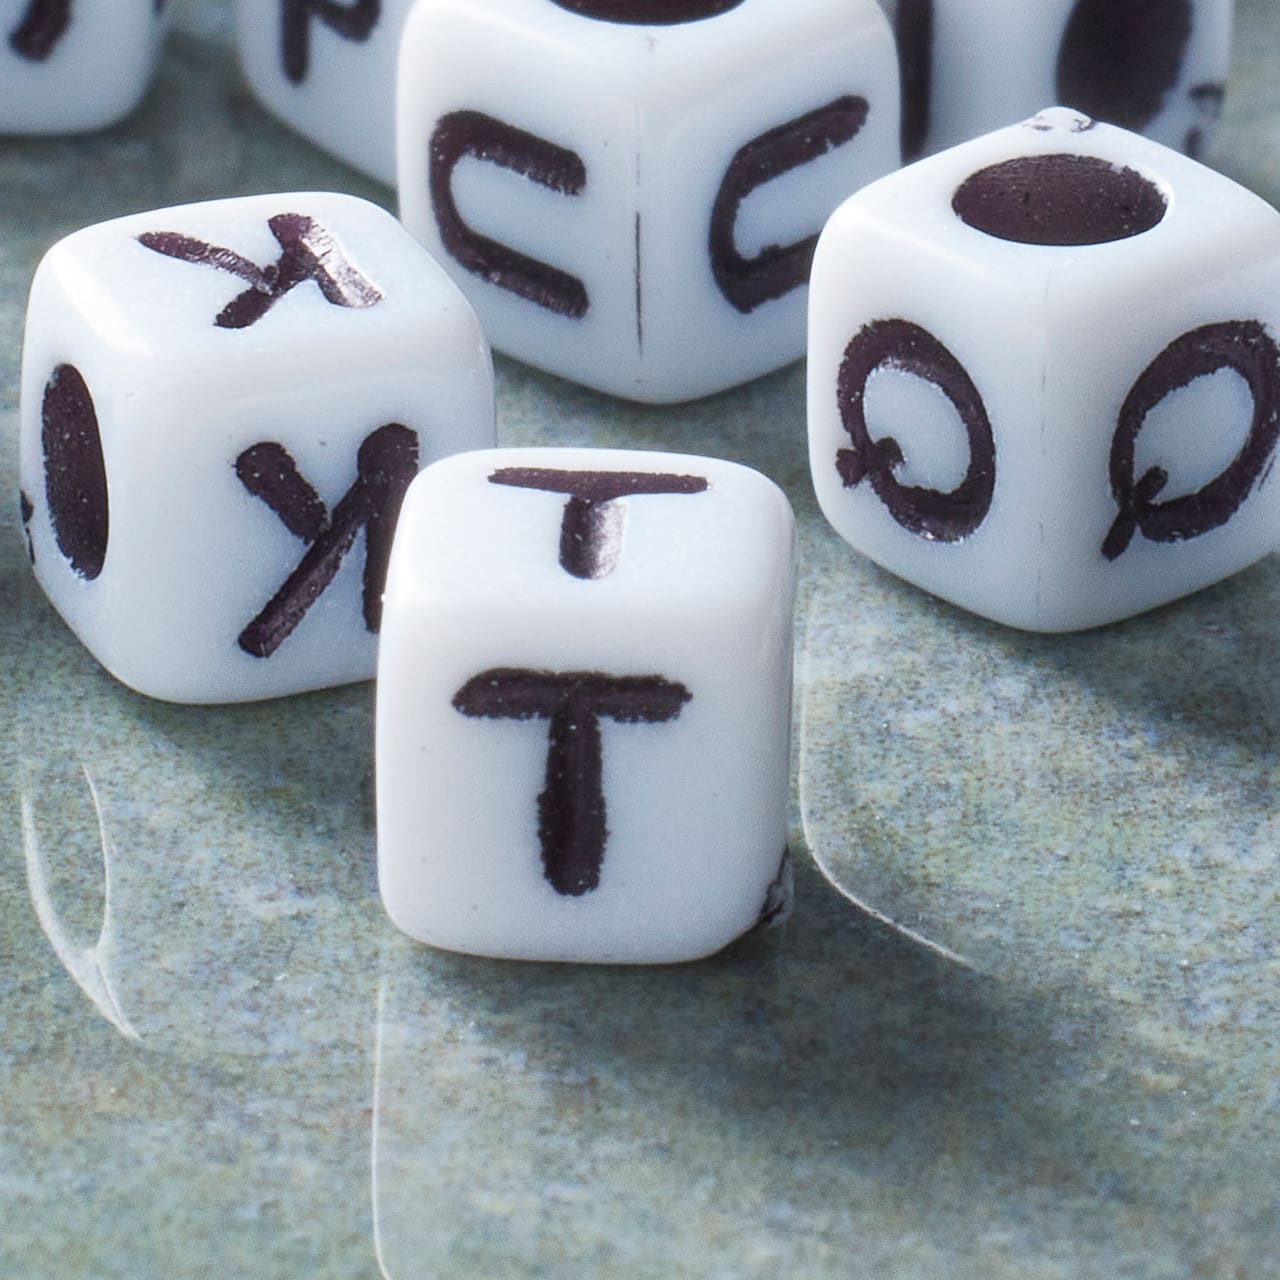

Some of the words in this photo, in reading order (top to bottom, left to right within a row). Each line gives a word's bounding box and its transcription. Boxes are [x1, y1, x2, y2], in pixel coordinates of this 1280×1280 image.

[136, 212, 384, 329] K
[234, 423, 419, 659] K
[487, 466, 710, 580] T
[835, 317, 997, 544] Q
[451, 666, 694, 897] T
